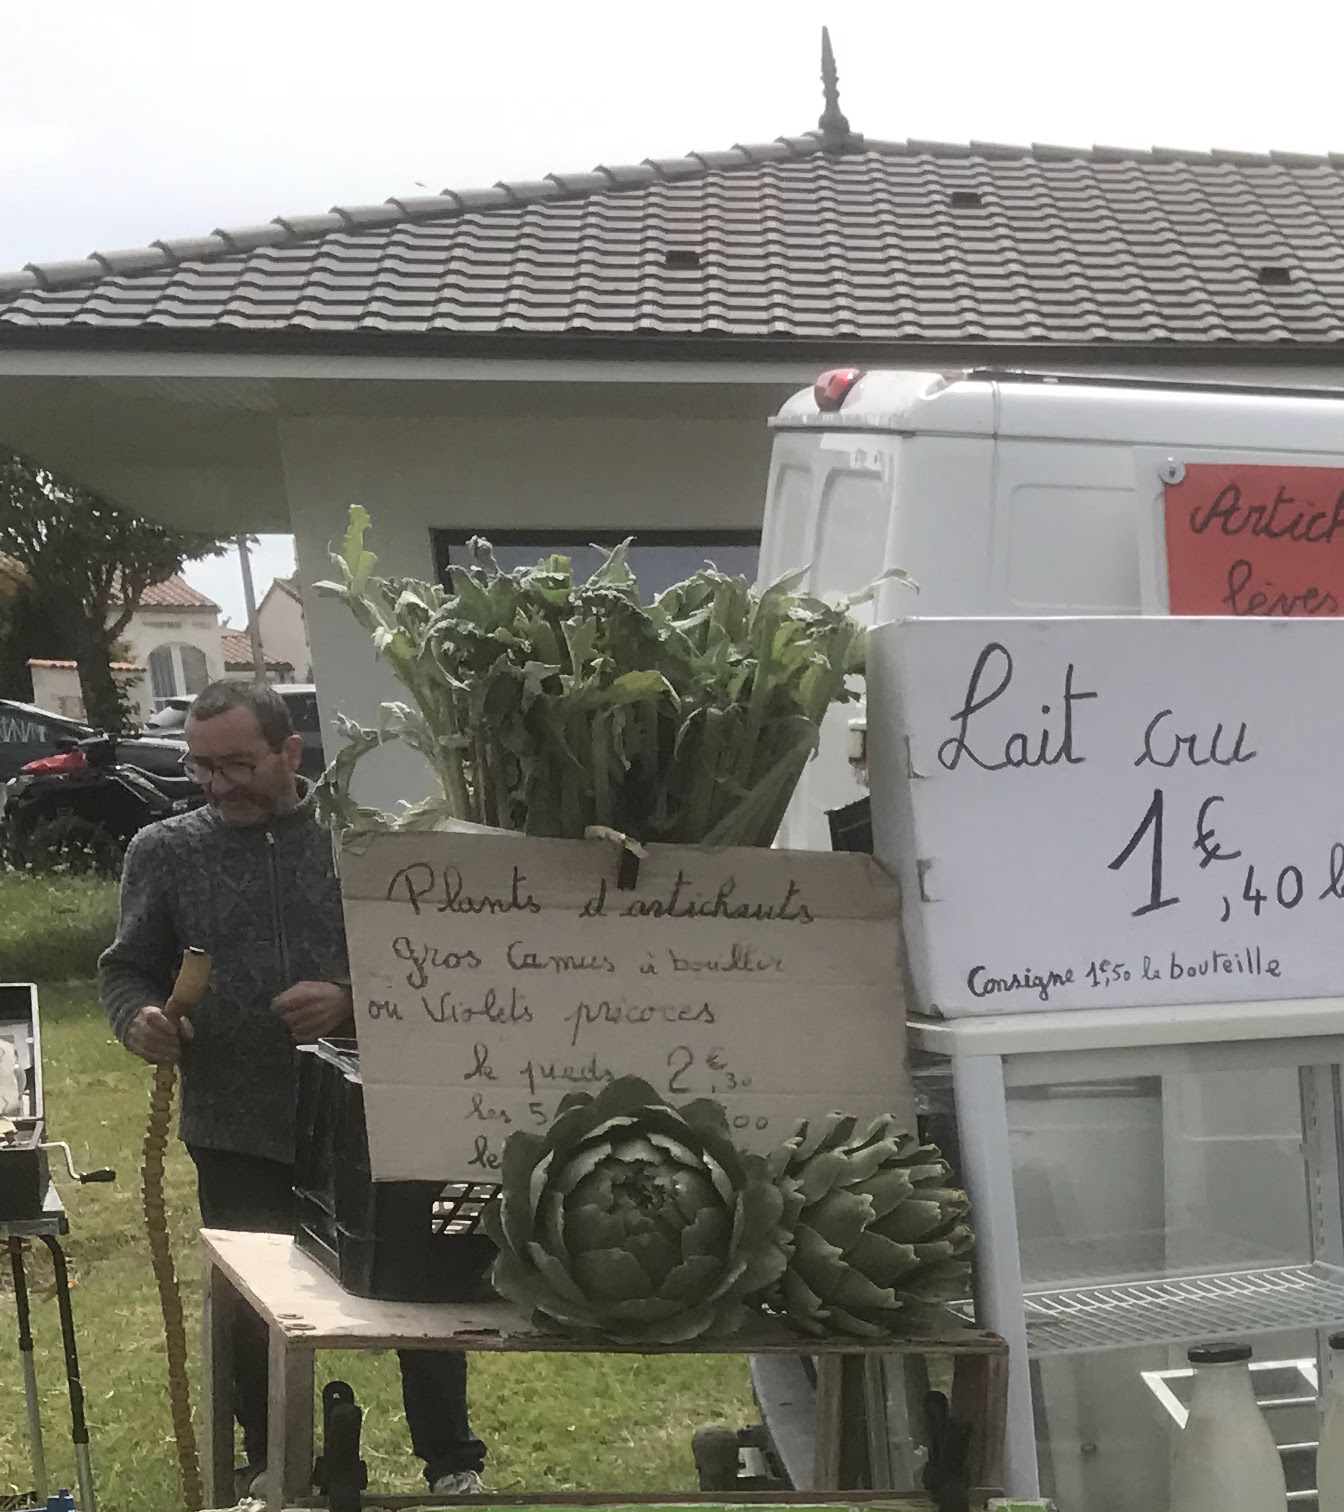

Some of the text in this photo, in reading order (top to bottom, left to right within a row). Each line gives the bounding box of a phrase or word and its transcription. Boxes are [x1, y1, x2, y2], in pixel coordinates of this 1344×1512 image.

[937, 642, 1099, 771] Lait
[386, 862, 542, 917] Plants
[967, 964, 1075, 1001] Consigne
[1170, 946, 1283, 980] bouteille
[464, 1043, 499, 1081] le
[464, 1095, 513, 1126] les
[528, 1102, 548, 1127] 5
